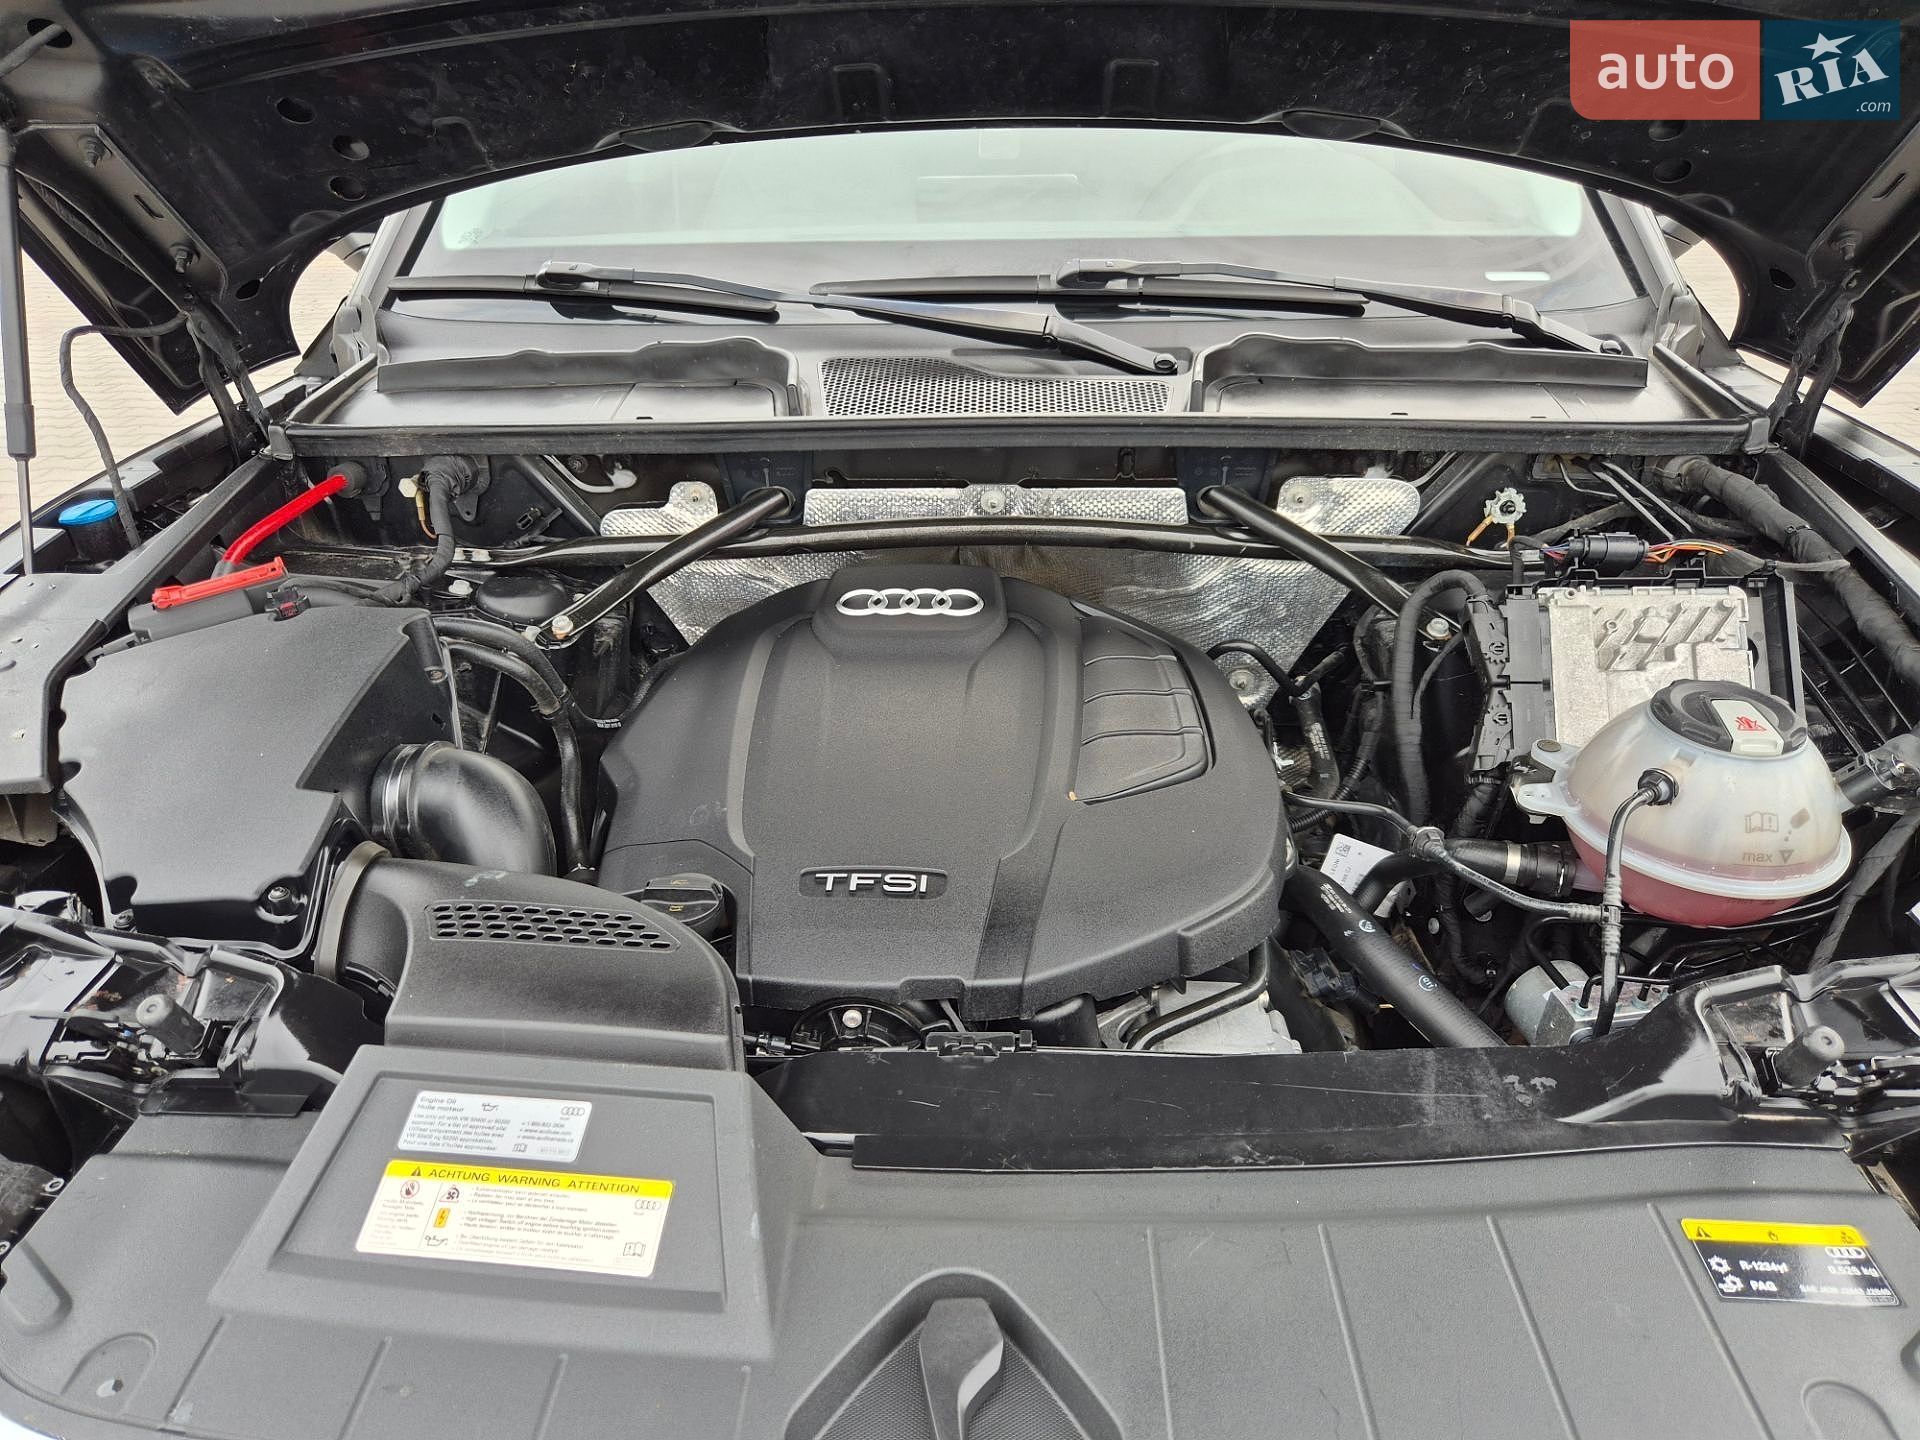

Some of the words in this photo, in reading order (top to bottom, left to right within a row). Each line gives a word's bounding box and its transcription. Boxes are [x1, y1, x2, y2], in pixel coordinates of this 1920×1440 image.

[1742, 852, 1774, 863] max
[815, 873, 928, 893] TFSI
[420, 1096, 445, 1104] Engine
[446, 1097, 457, 1105] Oil
[429, 1168, 490, 1182] ACHTUNG
[498, 1174, 561, 1187] WARNING
[567, 1179, 640, 1193] ATTENTION
